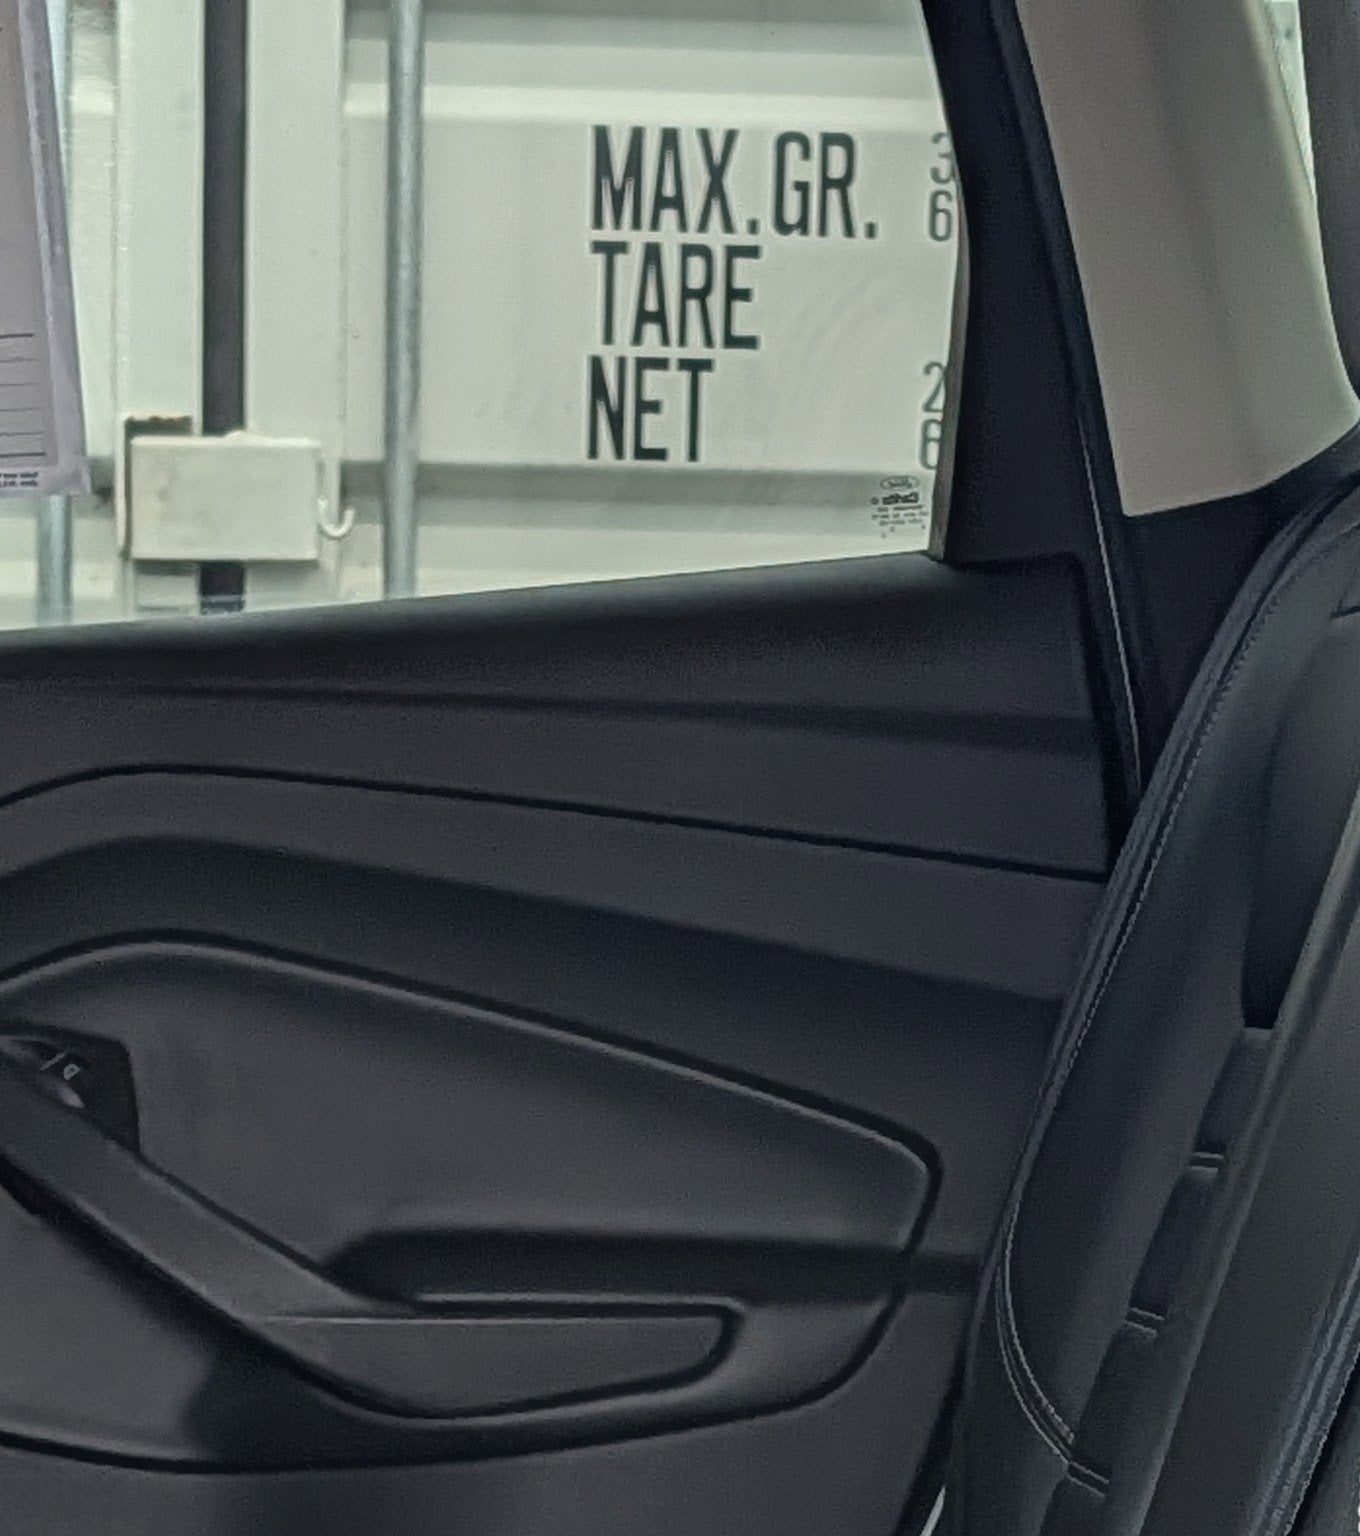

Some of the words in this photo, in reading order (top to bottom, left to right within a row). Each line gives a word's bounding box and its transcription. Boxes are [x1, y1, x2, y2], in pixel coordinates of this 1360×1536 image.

[591, 124, 878, 239] MAX.GR.
[590, 240, 761, 350] TARE
[587, 355, 714, 462] NET
